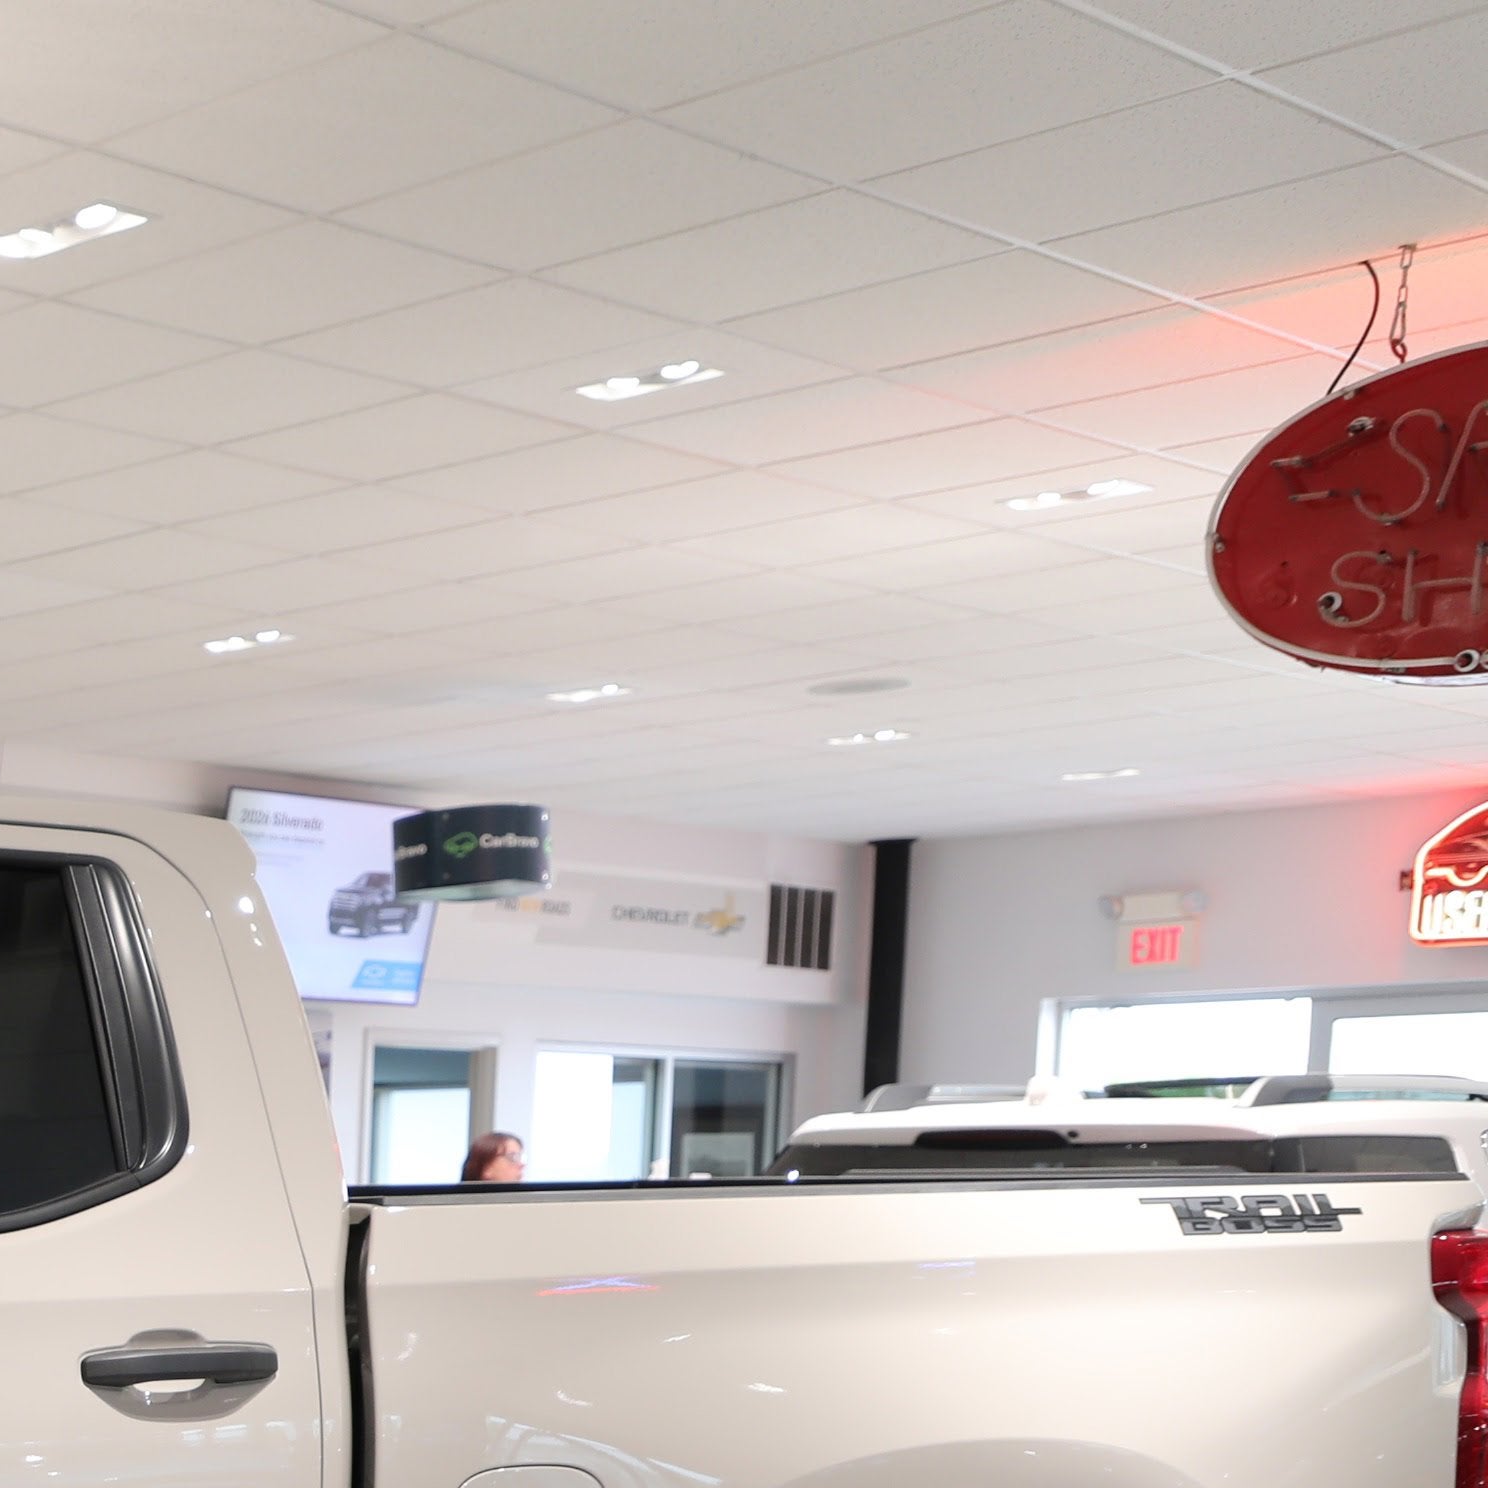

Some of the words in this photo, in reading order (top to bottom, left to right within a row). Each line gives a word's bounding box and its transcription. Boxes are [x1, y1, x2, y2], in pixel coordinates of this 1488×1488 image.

[479, 833, 540, 849] CarBravo
[1130, 925, 1184, 965] EXIT
[1139, 1193, 1363, 1218] TRAIL
[1179, 1215, 1343, 1236] BOSS
